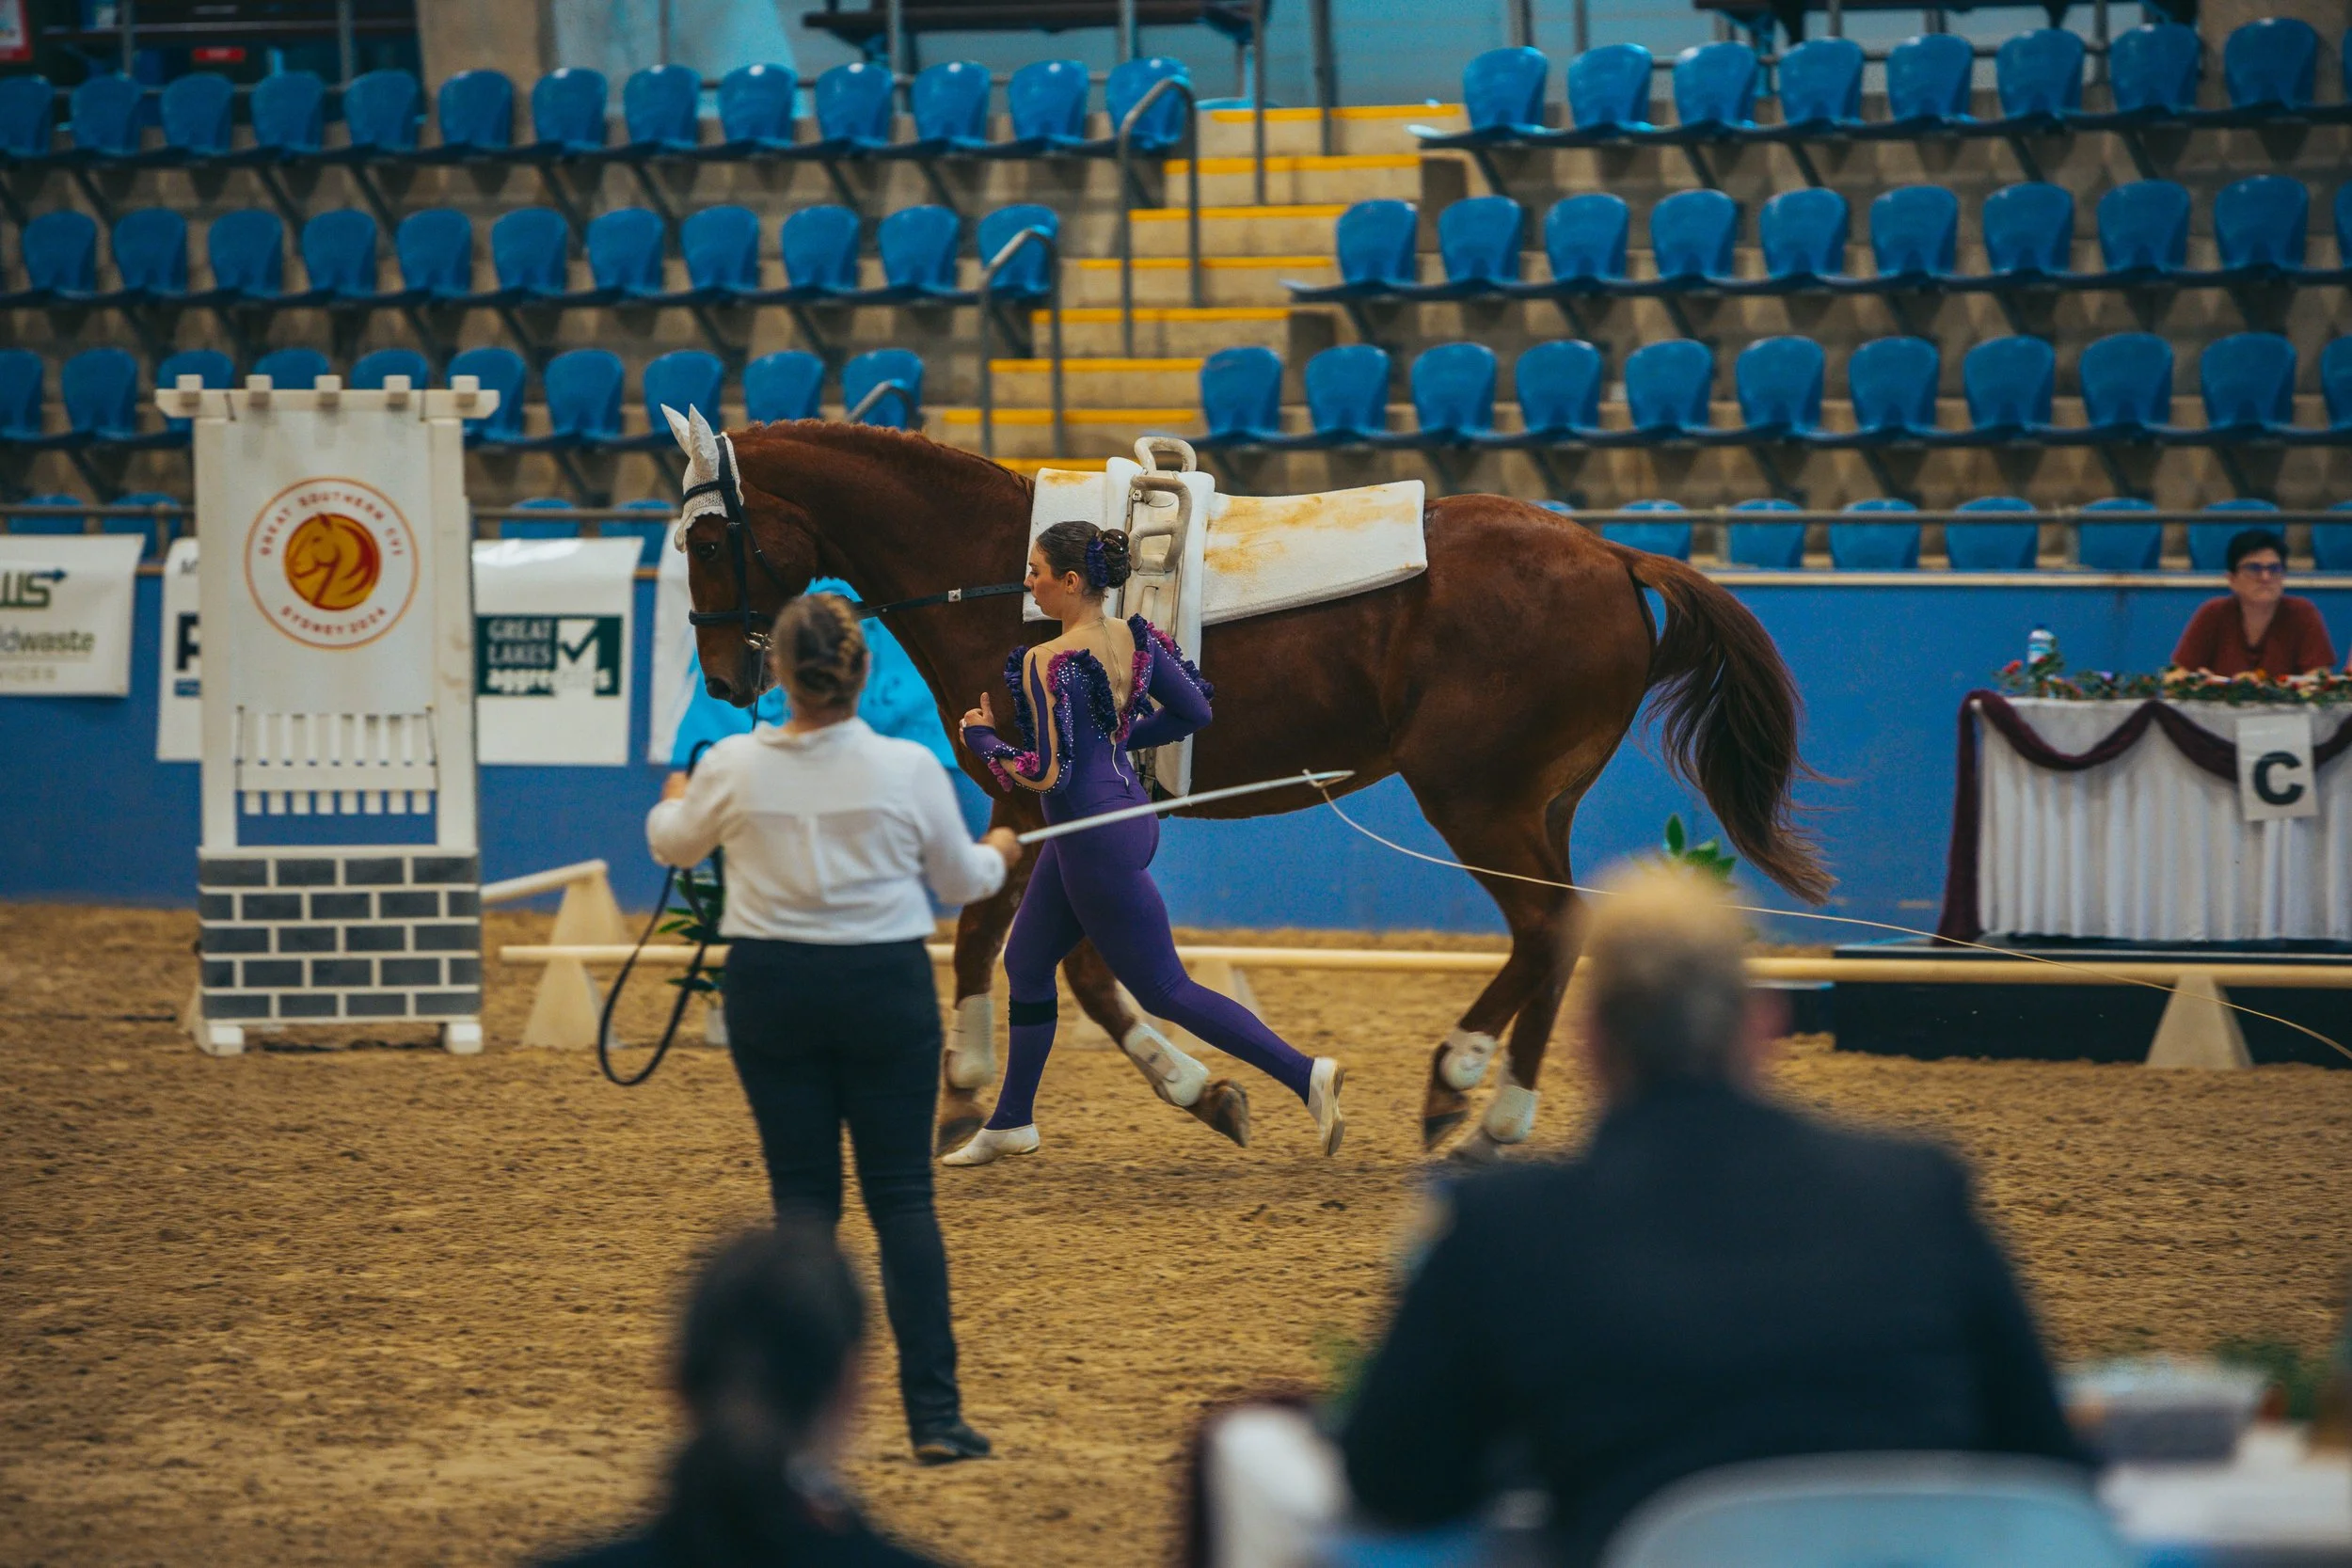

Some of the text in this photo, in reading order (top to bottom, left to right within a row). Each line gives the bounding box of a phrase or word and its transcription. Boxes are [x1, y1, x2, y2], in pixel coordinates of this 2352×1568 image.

[259, 507, 292, 556] GREAT
[297, 492, 385, 520] SOUTHERN
[281, 605, 344, 635] SYDNEY
[487, 619, 551, 641] GREAT
[487, 642, 551, 665] LAKES
[2253, 750, 2305, 806] C
